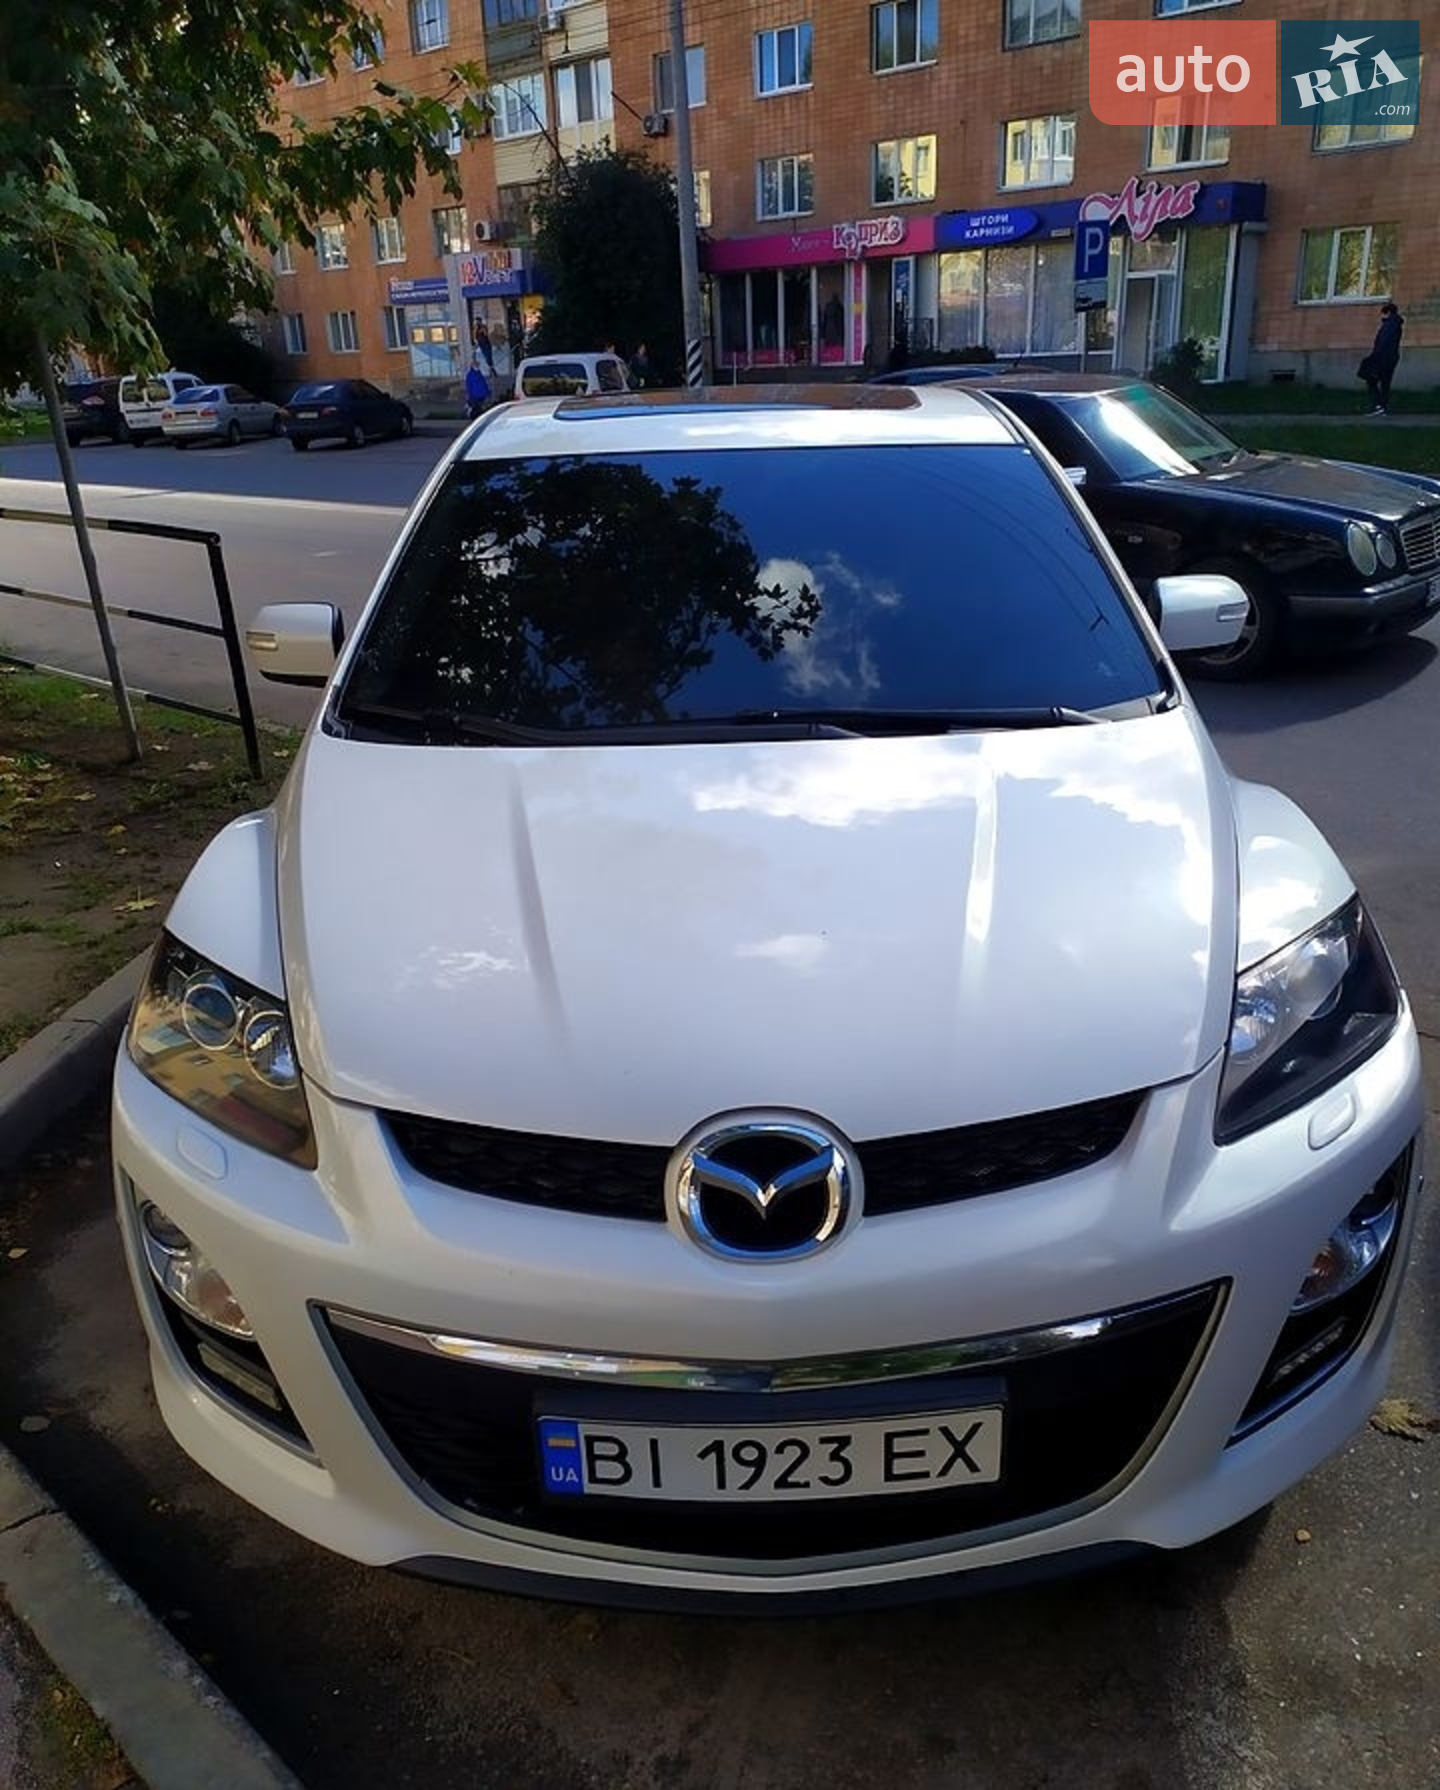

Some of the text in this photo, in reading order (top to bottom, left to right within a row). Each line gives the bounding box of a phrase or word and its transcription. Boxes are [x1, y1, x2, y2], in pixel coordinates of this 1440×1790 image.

[968, 213, 1009, 228] ШТОРИ
[1083, 226, 1105, 273] P
[583, 1421, 985, 1491] BI 1923 EX
[551, 1465, 579, 1483] UA
